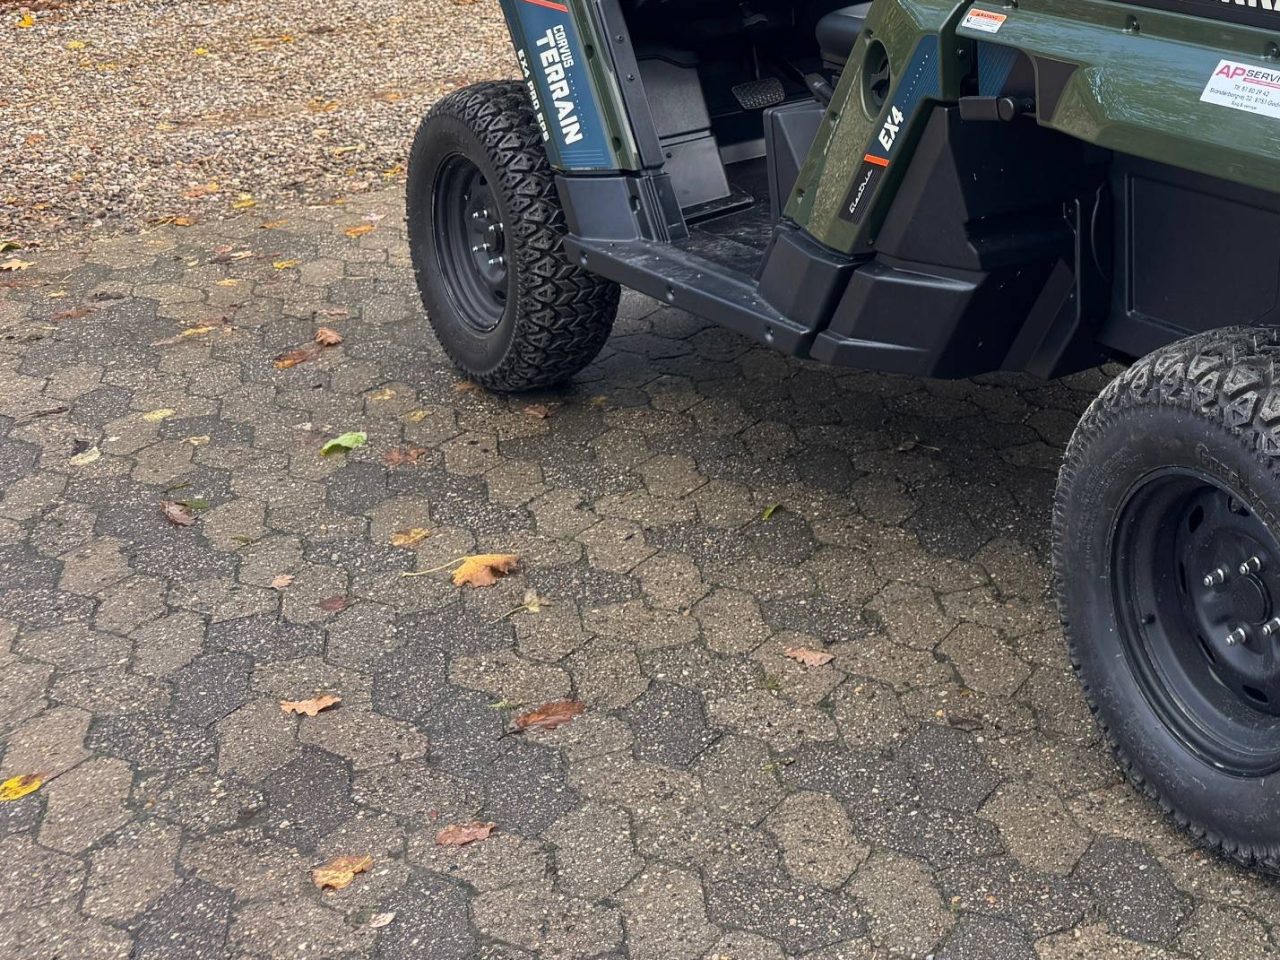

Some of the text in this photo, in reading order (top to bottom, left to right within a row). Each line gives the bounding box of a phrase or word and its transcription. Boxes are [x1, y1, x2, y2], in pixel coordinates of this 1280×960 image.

[517, 48, 531, 79] EX4
[553, 24, 575, 68] CORVUS
[536, 28, 584, 145] TERRAIN
[1215, 64, 1247, 79] AP
[878, 105, 904, 152] EX4
